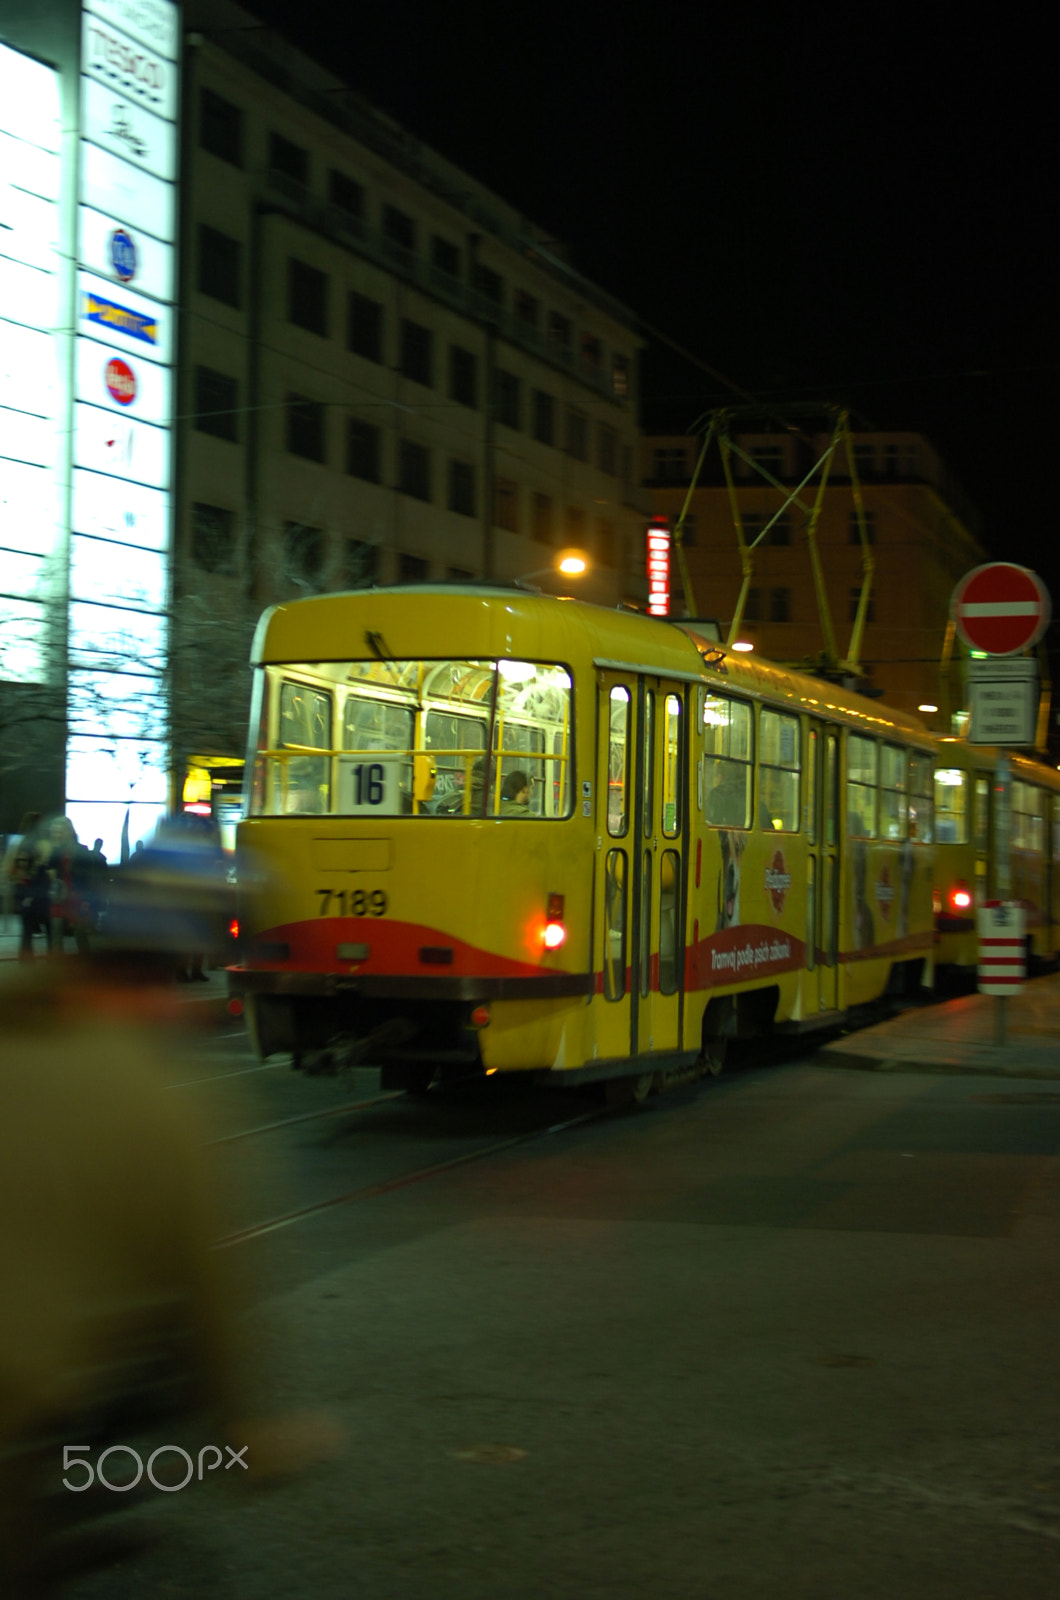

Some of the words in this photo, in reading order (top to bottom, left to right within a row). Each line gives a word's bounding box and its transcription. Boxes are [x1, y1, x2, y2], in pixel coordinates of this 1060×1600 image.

[88, 27, 166, 90] TESCO
[352, 764, 384, 805] 16
[315, 889, 388, 916] 7189
